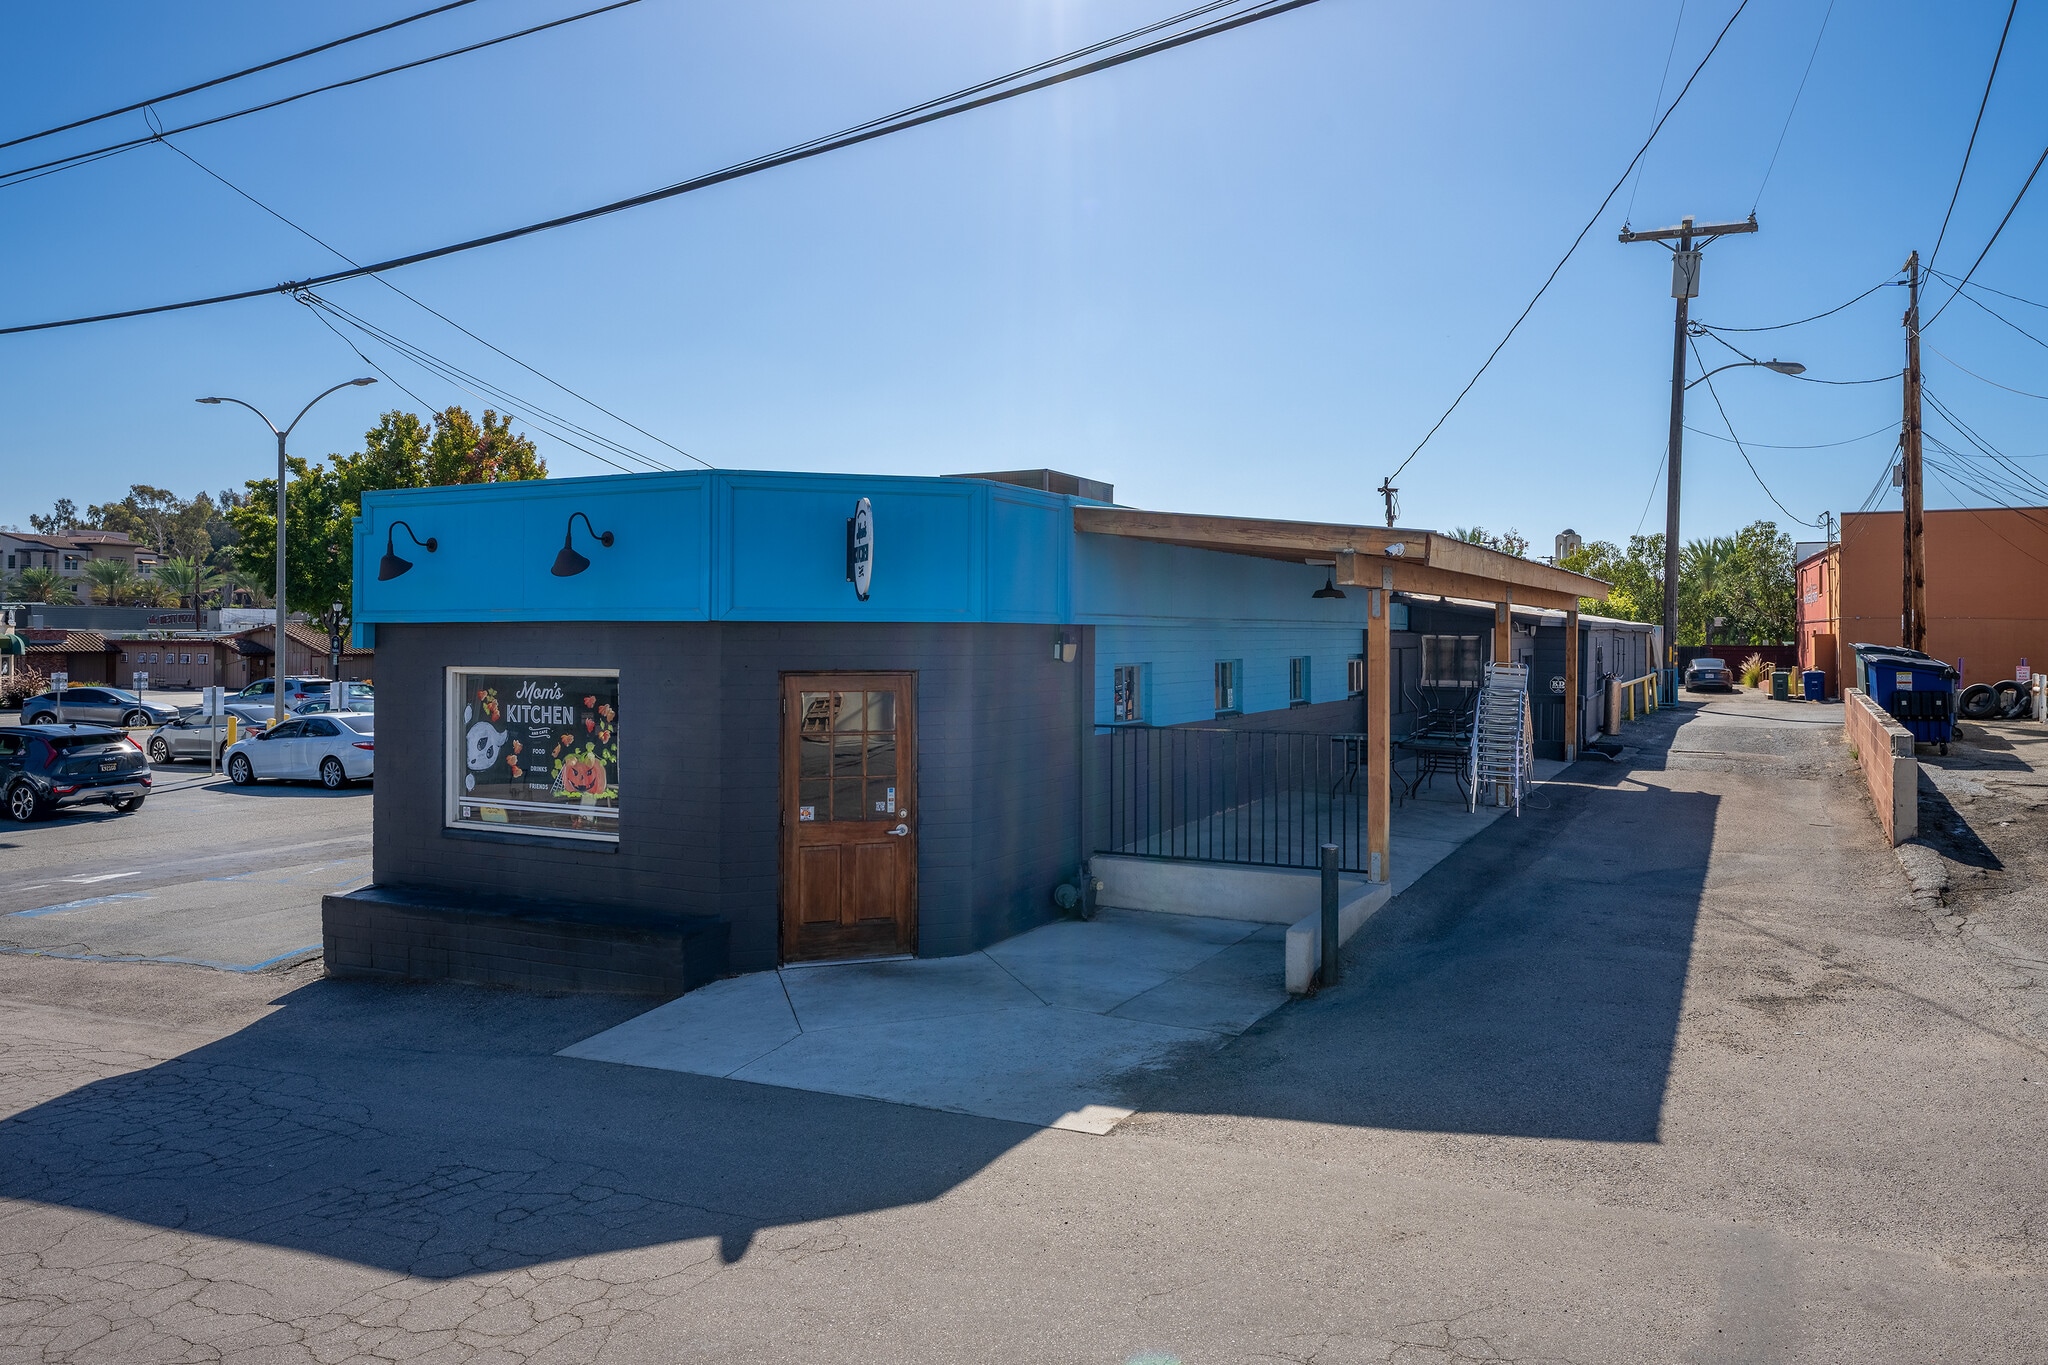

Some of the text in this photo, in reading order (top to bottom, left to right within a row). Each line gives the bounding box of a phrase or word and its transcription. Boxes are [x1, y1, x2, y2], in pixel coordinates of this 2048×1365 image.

[516, 680, 564, 704] Mom's
[506, 704, 574, 725] KITCHEN
[530, 765, 548, 773] DRINKS
[529, 782, 549, 790] FRIENDS
